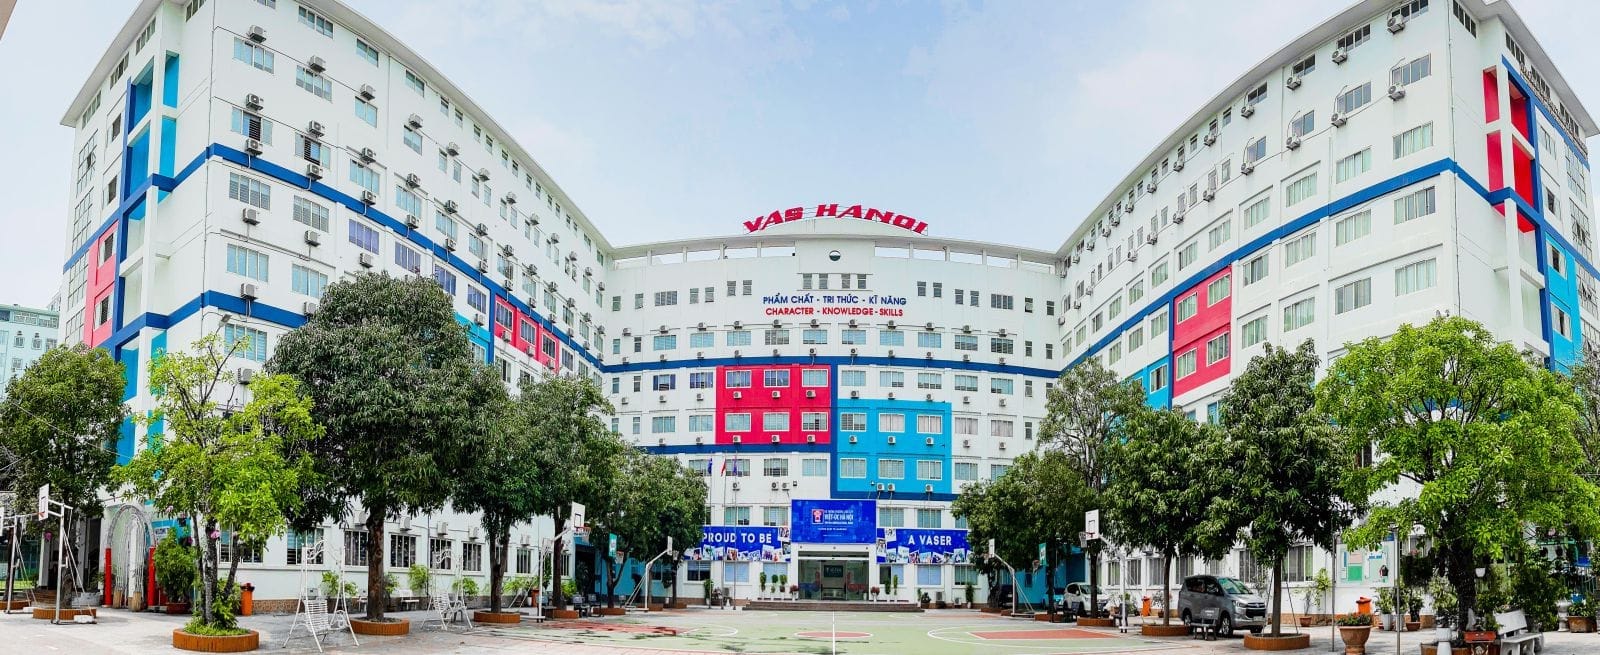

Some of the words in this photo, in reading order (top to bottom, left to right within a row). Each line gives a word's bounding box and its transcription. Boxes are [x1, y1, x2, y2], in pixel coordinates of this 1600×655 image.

[743, 207, 804, 233] VAS
[816, 203, 928, 234] HANOI
[763, 293, 788, 305] PHẨM
[790, 293, 814, 304] CHẤT
[823, 295, 835, 304] TRI
[836, 293, 859, 304] THỨC
[880, 295, 907, 305] NĂNG
[765, 307, 814, 316] CHARACTER
[822, 307, 873, 316] KNOWLEDGE
[879, 308, 904, 317] SKILLS
[702, 532, 737, 543] PROUD
[741, 533, 756, 543] TO
[759, 533, 772, 544] BE
[908, 534, 915, 545] A
[919, 535, 952, 546] VASER
